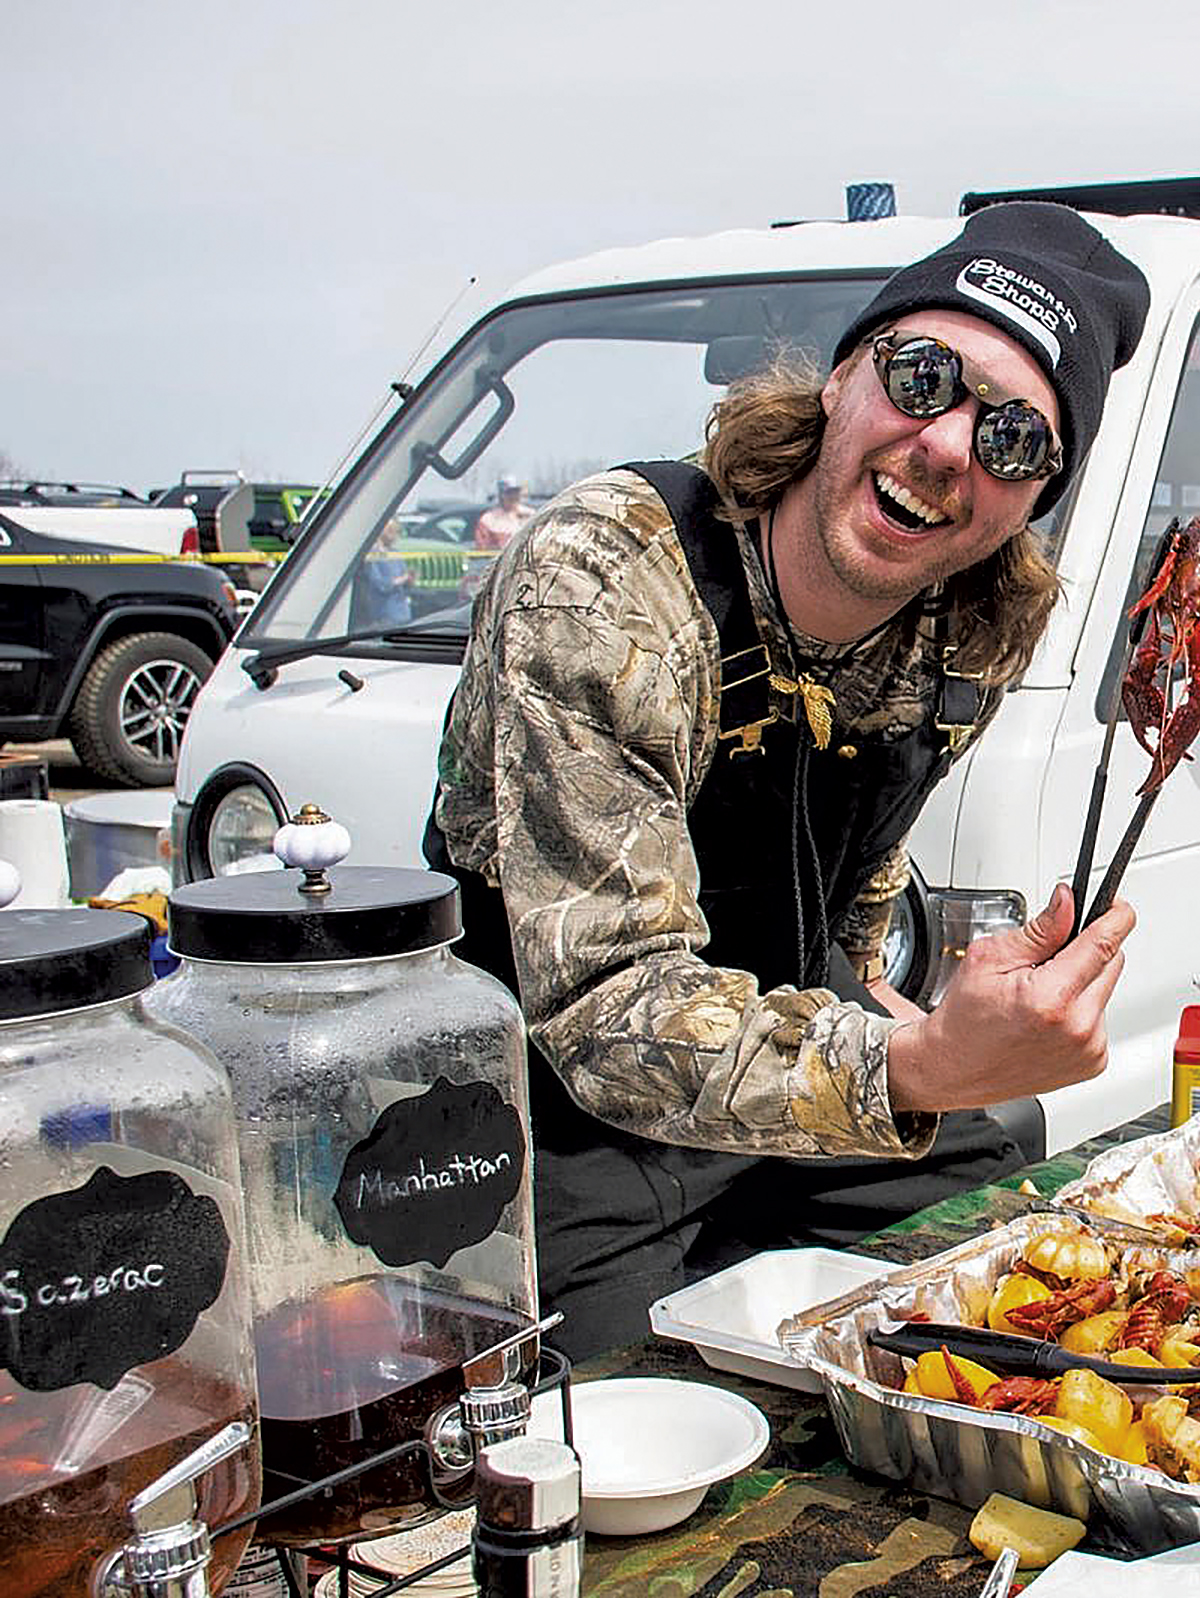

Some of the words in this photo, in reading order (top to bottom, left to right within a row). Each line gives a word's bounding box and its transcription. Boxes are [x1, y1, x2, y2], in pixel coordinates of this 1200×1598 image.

[981, 275, 1060, 332] Shops
[357, 1152, 511, 1209] Manhattan
[0, 1264, 165, 1315] Sazerac
